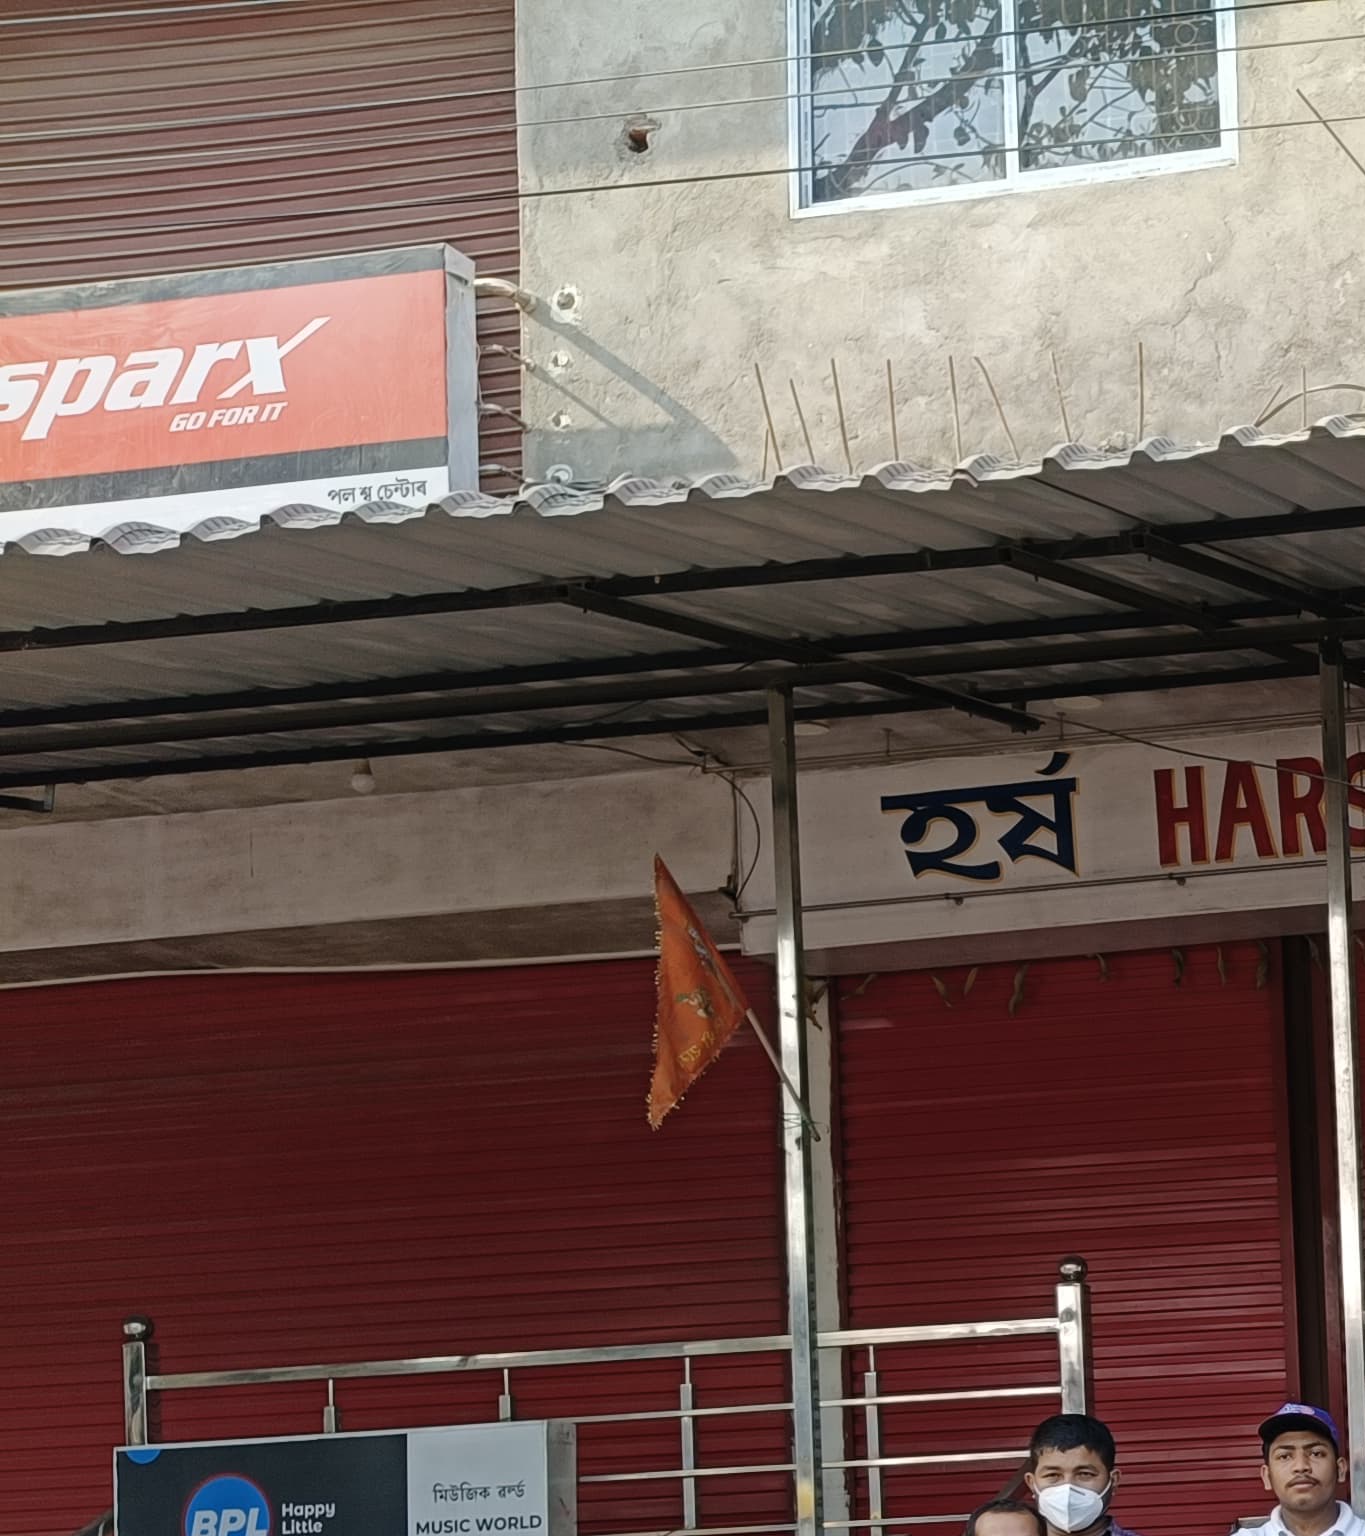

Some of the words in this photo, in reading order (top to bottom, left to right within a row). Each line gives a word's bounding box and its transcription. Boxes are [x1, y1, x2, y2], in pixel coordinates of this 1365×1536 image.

[0, 316, 332, 441] sparx
[169, 412, 207, 432] GO
[209, 408, 258, 428] FOR
[260, 401, 288, 423] IT
[281, 1502, 336, 1519] Happy
[281, 1519, 323, 1535] Little
[416, 1519, 471, 1535] MUSIC
[475, 1514, 542, 1532] WORLD
